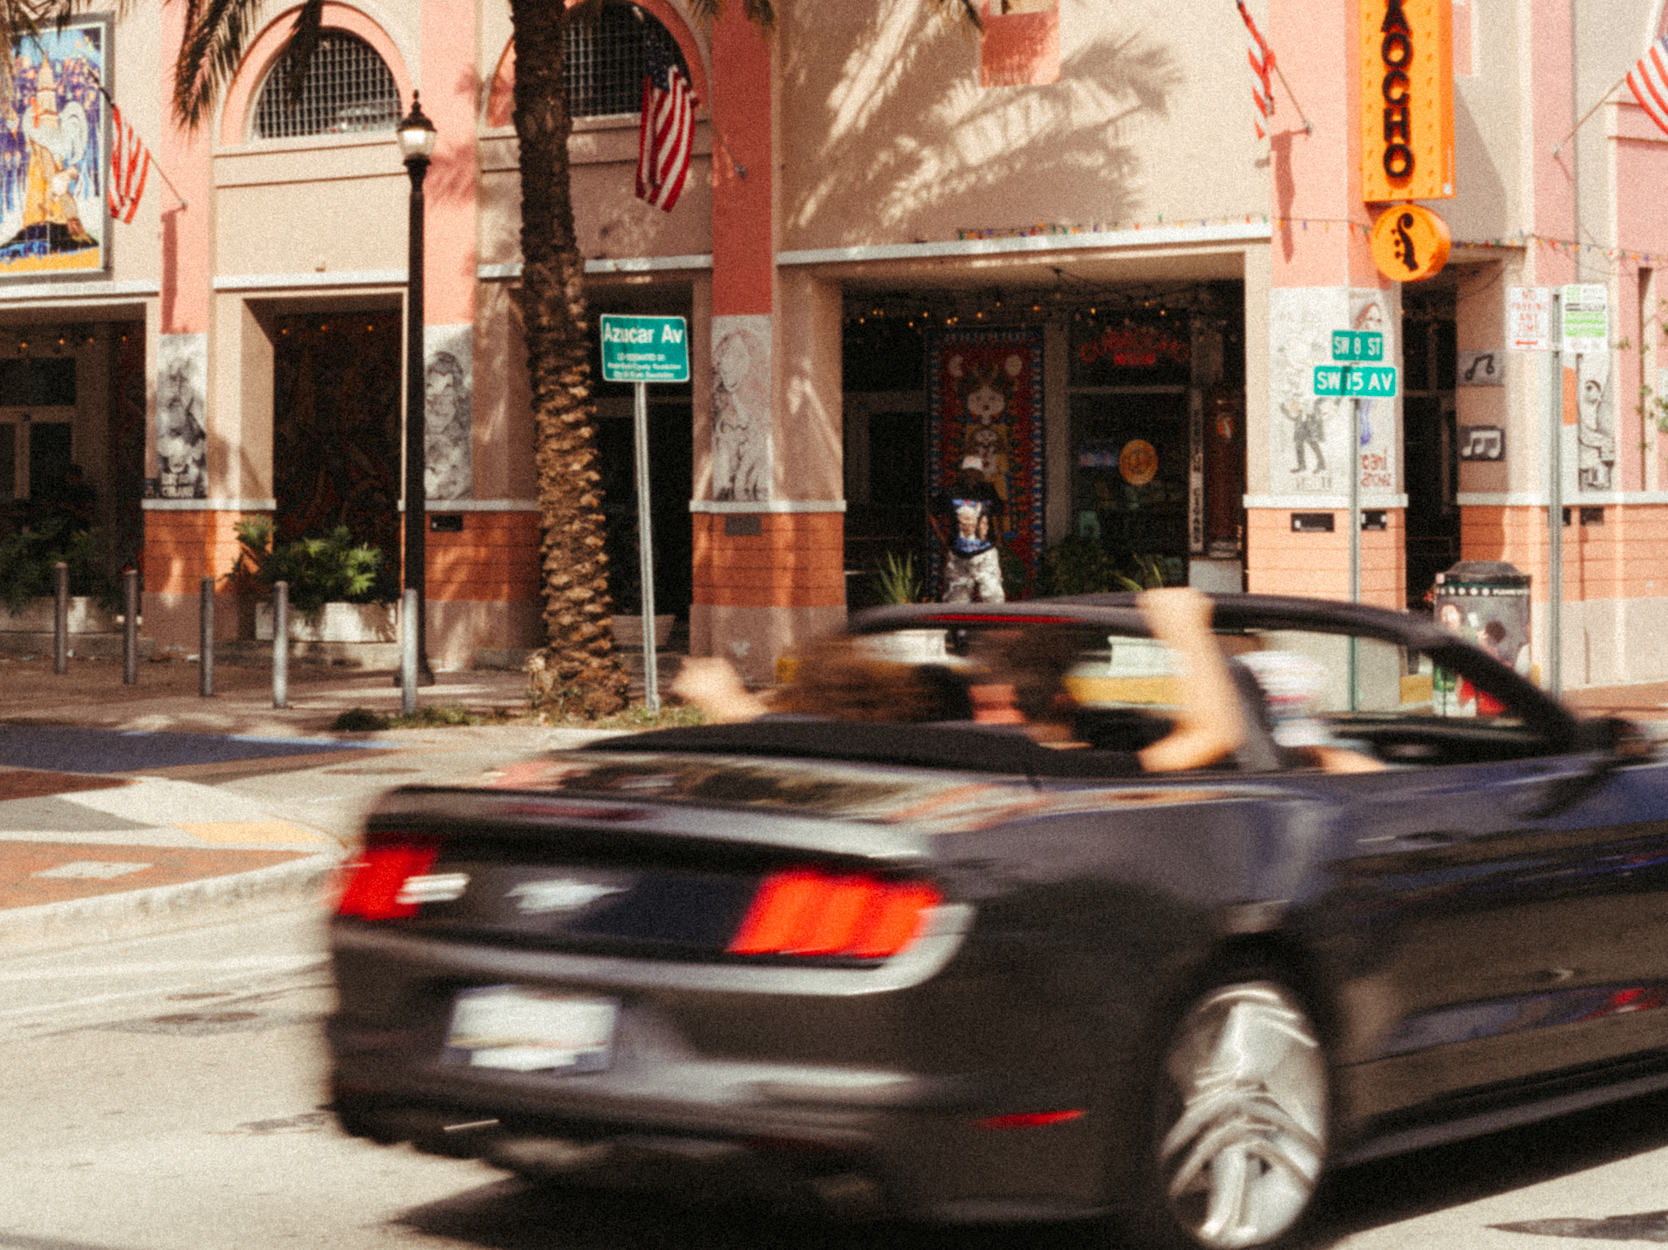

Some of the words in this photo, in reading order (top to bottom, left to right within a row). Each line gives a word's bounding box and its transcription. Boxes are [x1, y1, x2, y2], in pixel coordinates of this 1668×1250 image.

[1522, 291, 1536, 301] NO
[1520, 313, 1538, 321] ANY
[604, 322, 655, 344] Azucar
[661, 324, 683, 344] Av
[1081, 329, 1190, 363] CUBAOCHO
[1334, 336, 1350, 355] SW
[1353, 336, 1362, 356] 8
[1367, 337, 1382, 356] ST
[1316, 370, 1341, 390] SW
[1345, 371, 1364, 391] 15
[1367, 372, 1394, 392] AV
